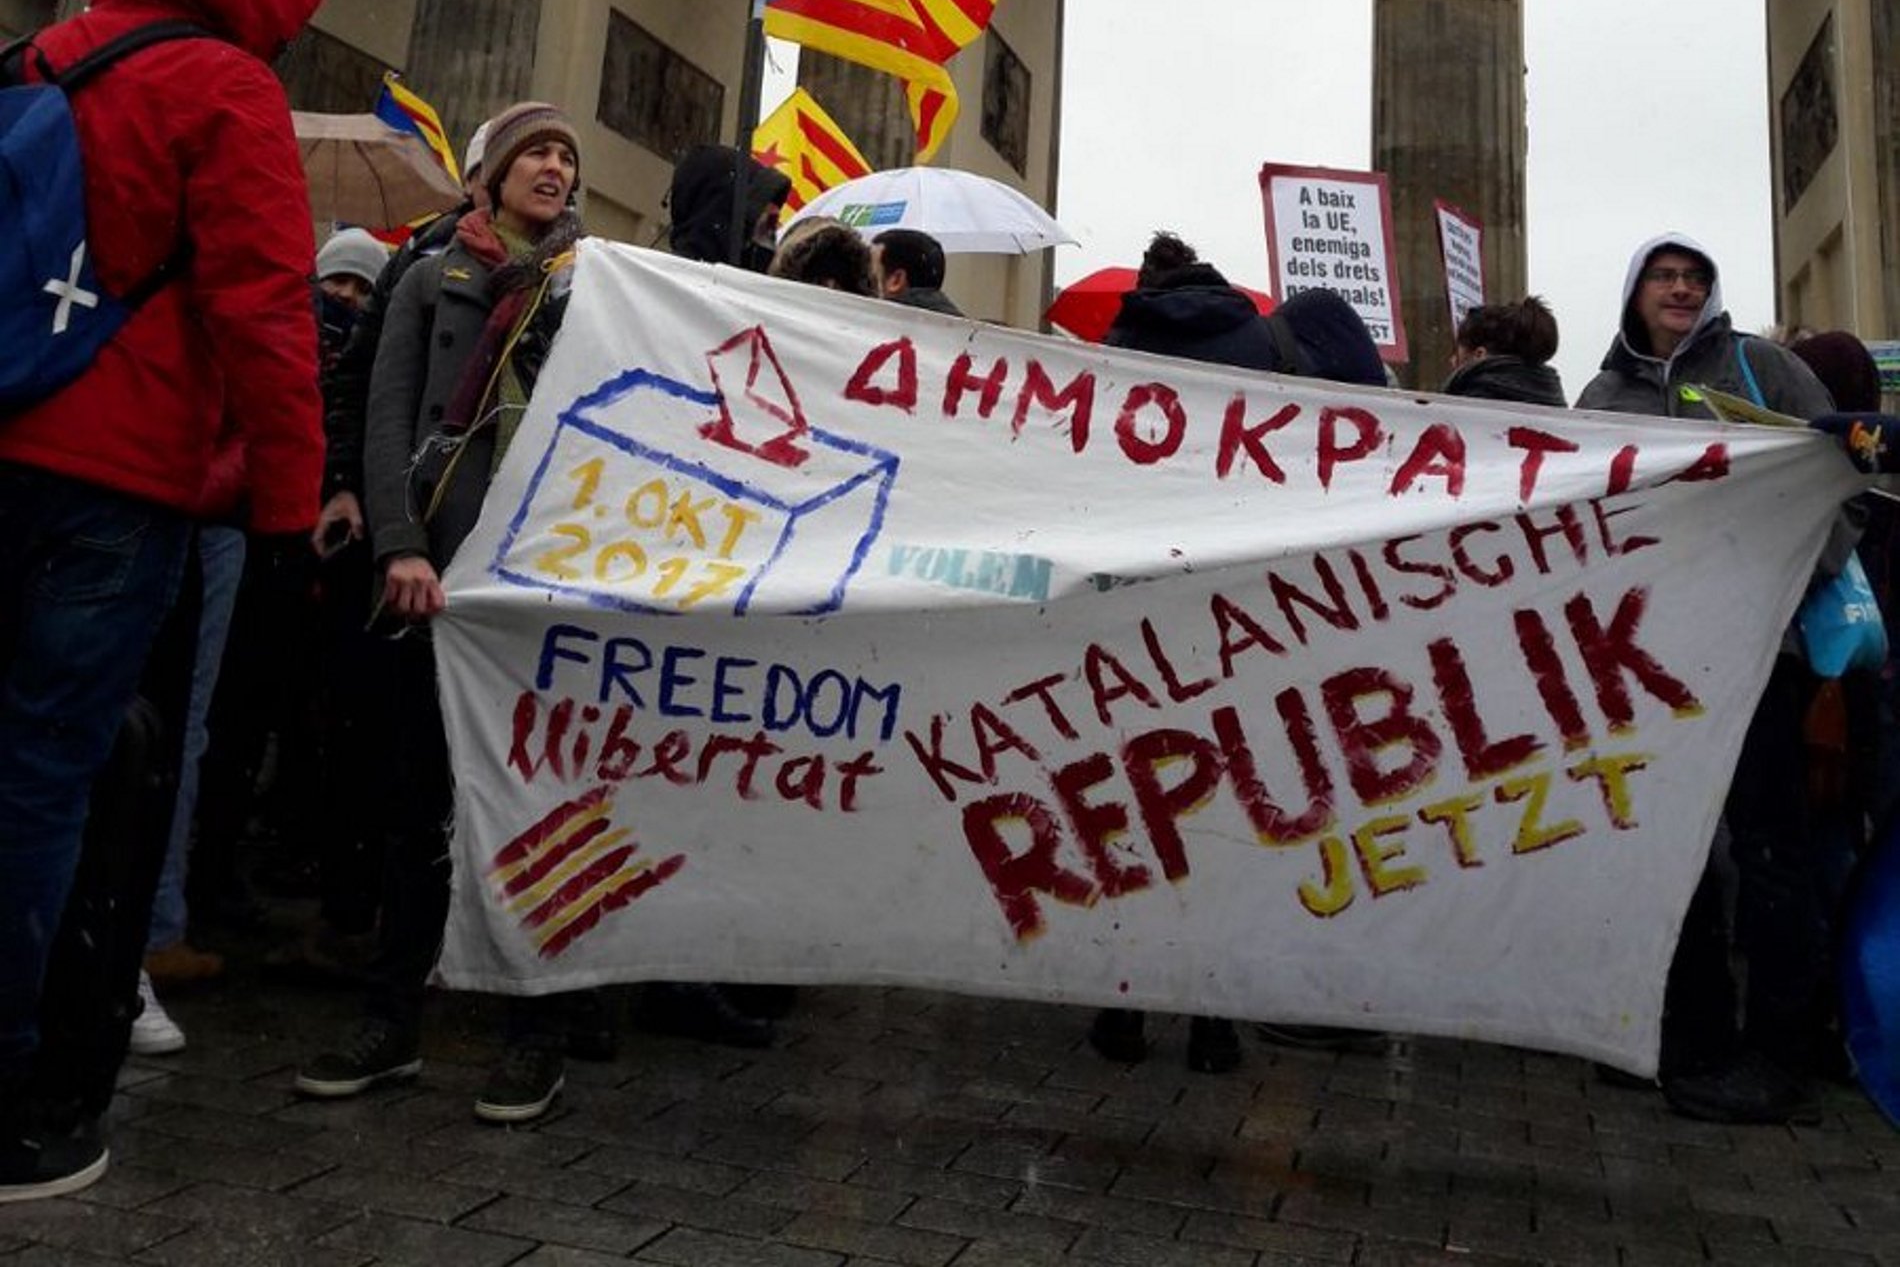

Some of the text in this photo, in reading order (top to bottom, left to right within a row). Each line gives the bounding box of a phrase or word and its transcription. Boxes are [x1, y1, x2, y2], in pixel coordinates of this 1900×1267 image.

[1299, 186, 1356, 209] A baix
[1302, 210, 1359, 234] la UE,
[1286, 257, 1380, 283] dels drets
[1291, 235, 1371, 259] enemiga
[624, 477, 762, 559] OKT
[533, 522, 746, 609] 2017
[536, 624, 902, 741] FREEDOM
[904, 497, 1662, 803] KATALANISCHE
[961, 585, 1704, 944] REPUBLIK
[1297, 752, 1654, 919] JETZT
